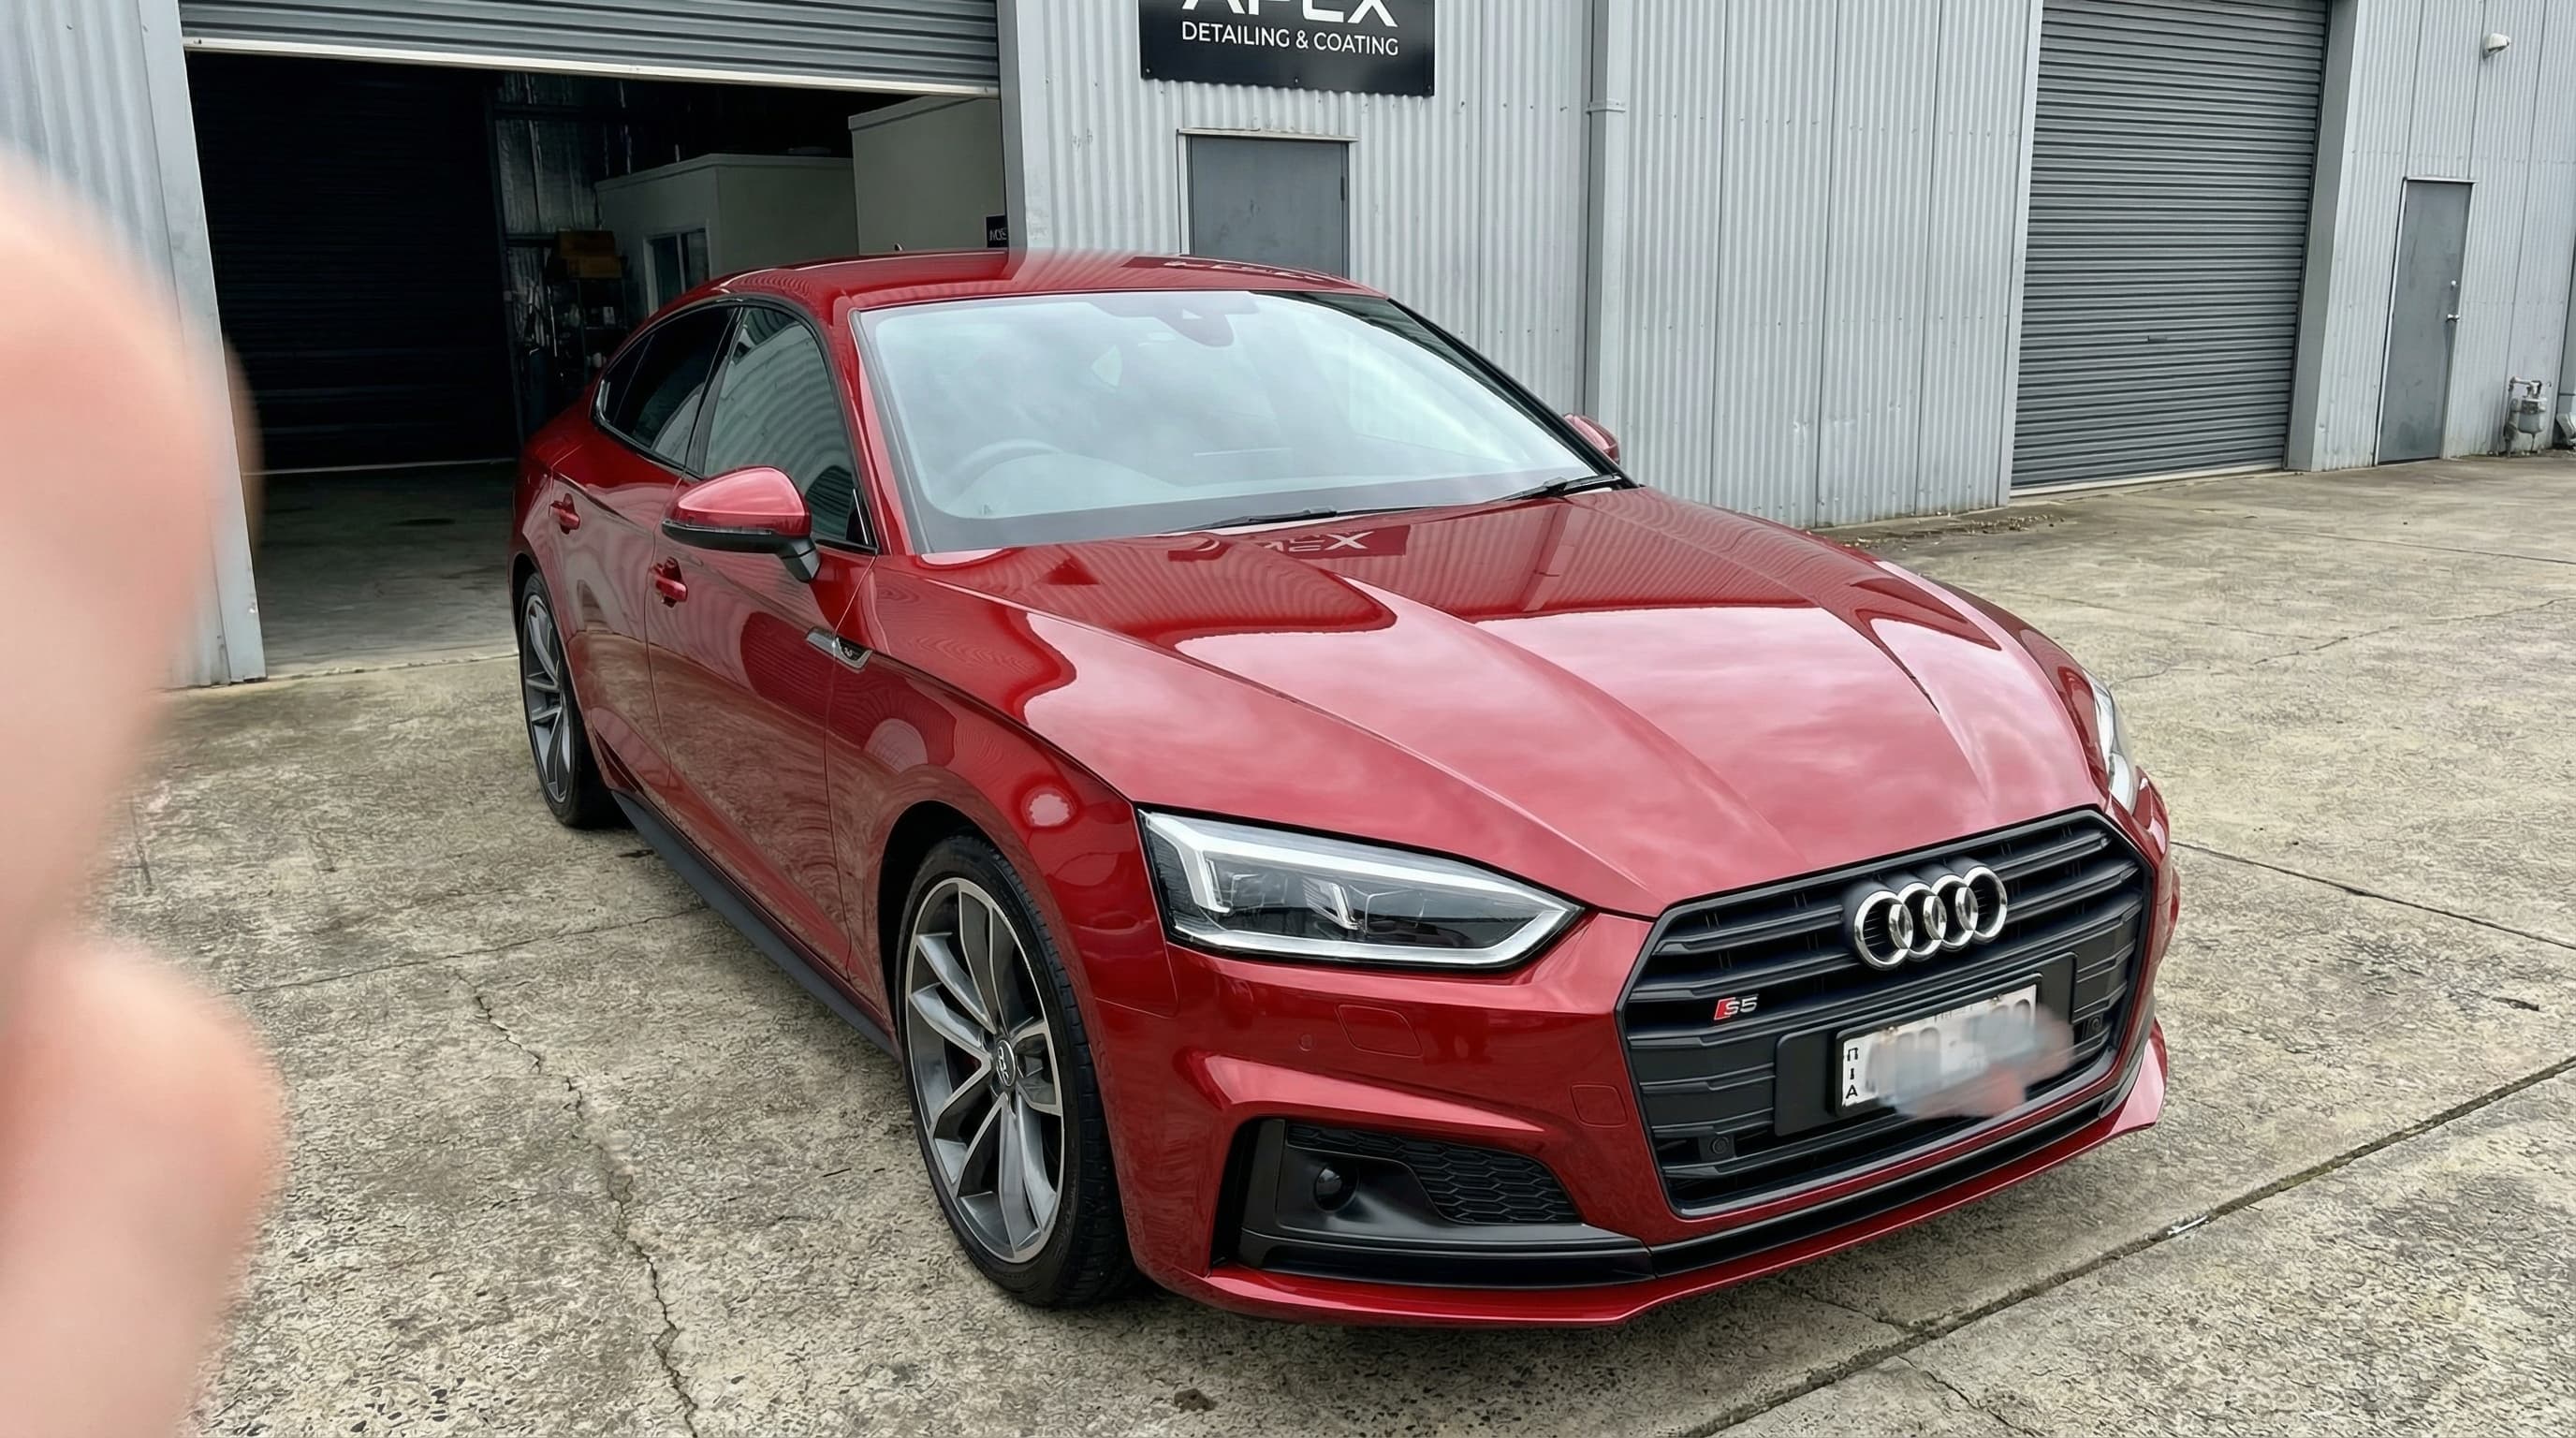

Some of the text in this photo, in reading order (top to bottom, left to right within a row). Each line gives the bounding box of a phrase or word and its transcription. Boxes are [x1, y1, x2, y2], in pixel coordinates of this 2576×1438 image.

[1181, 21, 1399, 57] DETAILING & COATING
[1723, 995, 1759, 1016] S5
